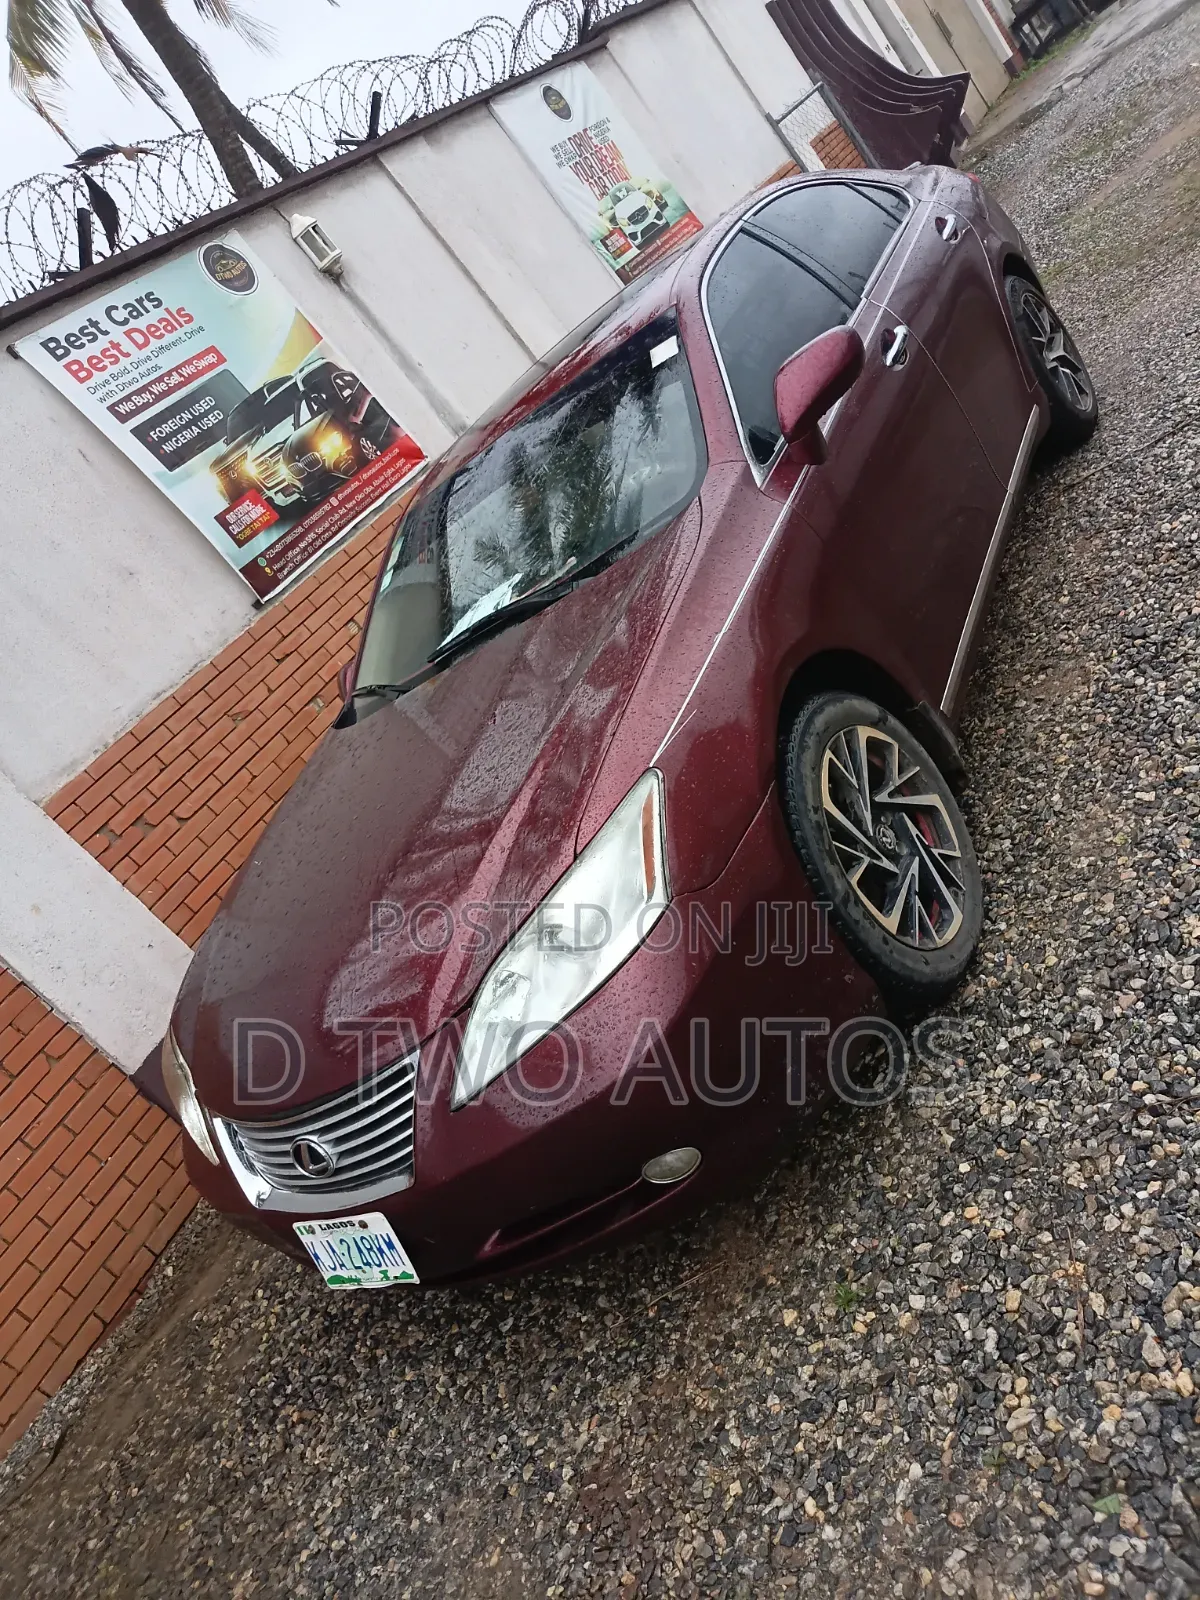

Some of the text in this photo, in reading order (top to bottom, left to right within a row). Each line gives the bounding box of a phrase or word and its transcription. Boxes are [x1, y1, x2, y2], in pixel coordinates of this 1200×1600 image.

[567, 128, 599, 159] DRIVE
[569, 139, 624, 185] YOUR DREAM
[588, 160, 632, 201] CAR TODAY
[39, 291, 163, 362] Best Cars
[63, 306, 195, 385] Best Deals
[87, 325, 206, 395] Drive Bold. Drive Different. Drive
[96, 363, 164, 404] with Dtwo Autos.
[115, 352, 218, 415] We Buy, We Sell, We Swap
[149, 396, 216, 442] FOREIGN USED
[161, 410, 224, 454] NIGERIA USED
[225, 499, 255, 524] OUR SERVICE
[229, 503, 267, 535] CALLS FOR MORE
[272, 558, 286, 571] Head
[285, 547, 300, 561] Office
[298, 541, 308, 549] No
[316, 520, 330, 534] Social
[328, 513, 340, 524] Club
[277, 562, 295, 580] Branch
[294, 551, 309, 564] Office
[318, 1220, 356, 1231] LAGOS
